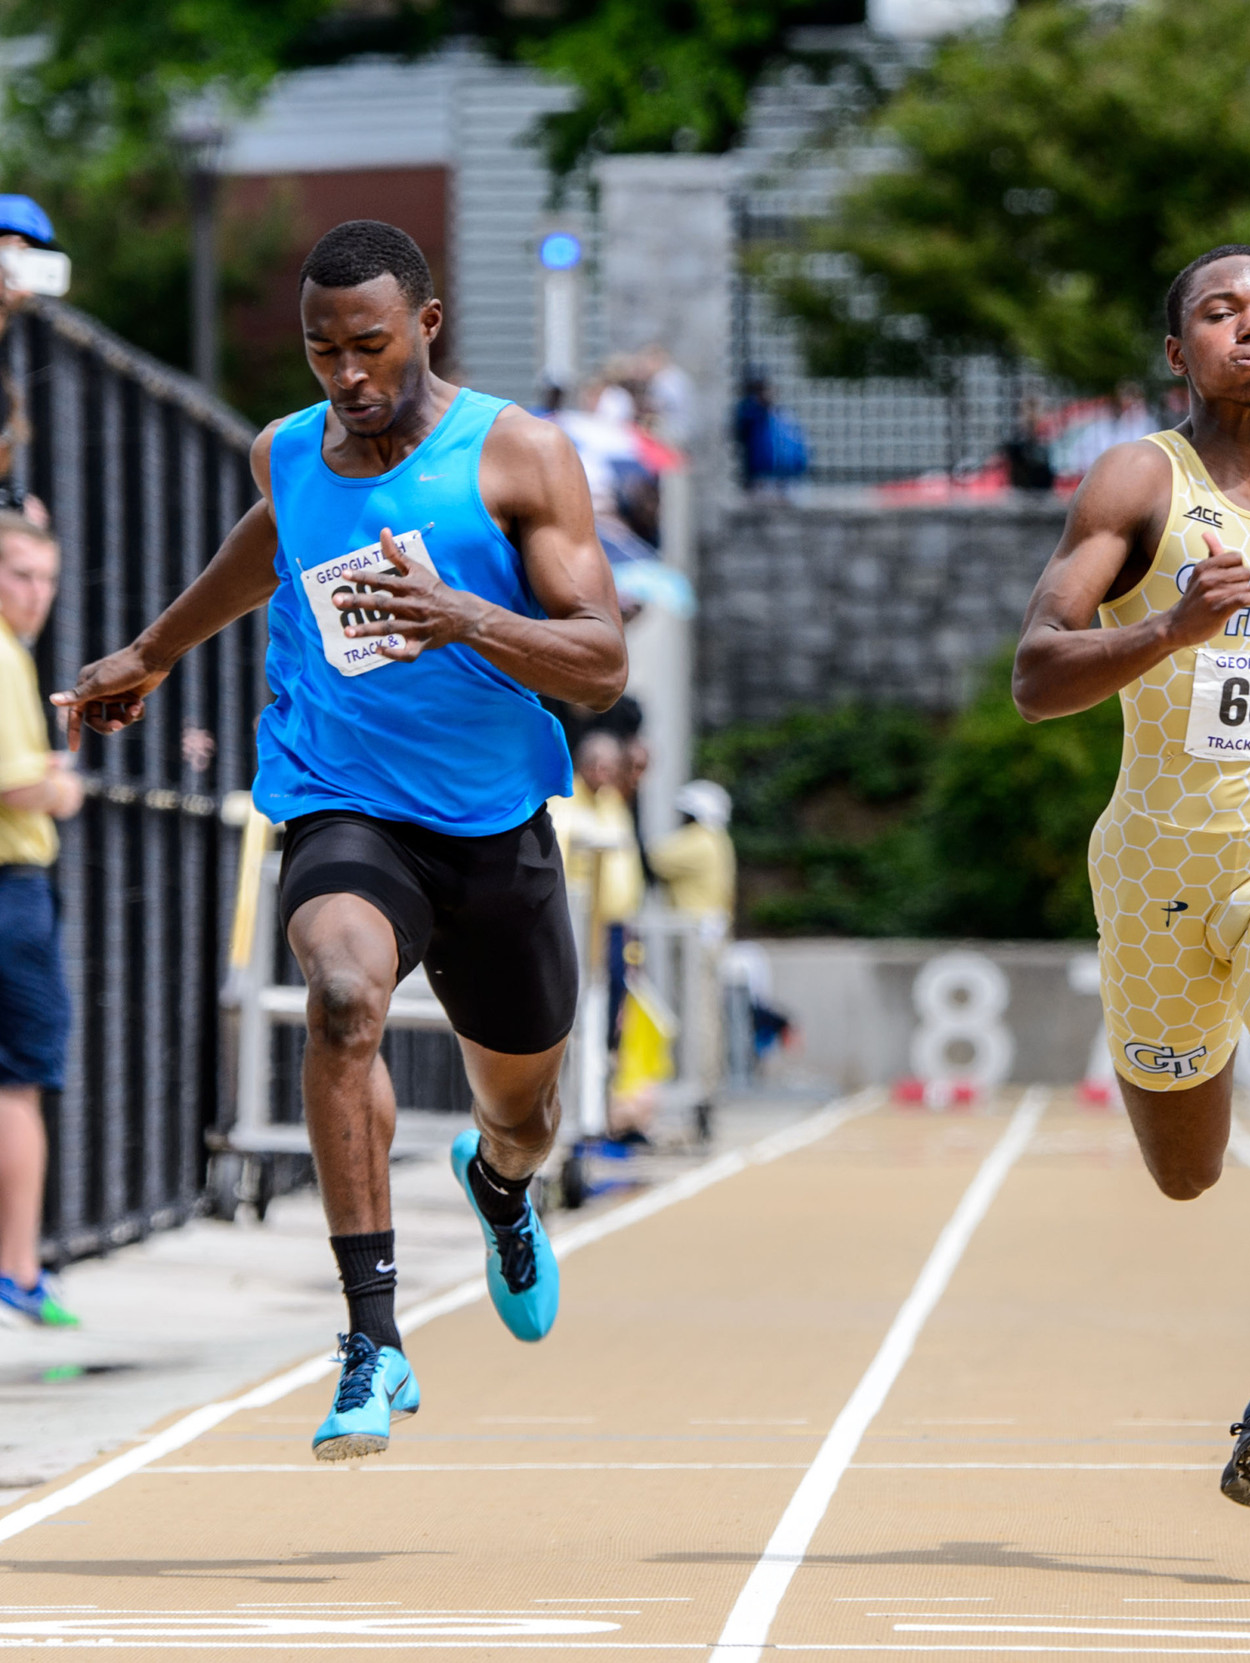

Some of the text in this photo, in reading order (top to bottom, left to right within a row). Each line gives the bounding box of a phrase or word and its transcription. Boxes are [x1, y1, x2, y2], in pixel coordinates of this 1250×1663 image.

[1186, 505, 1223, 526] ACC
[373, 541, 407, 563] TH
[388, 635, 399, 648] &
[912, 949, 1014, 1090] 8
[1124, 1042, 1207, 1079] GT
